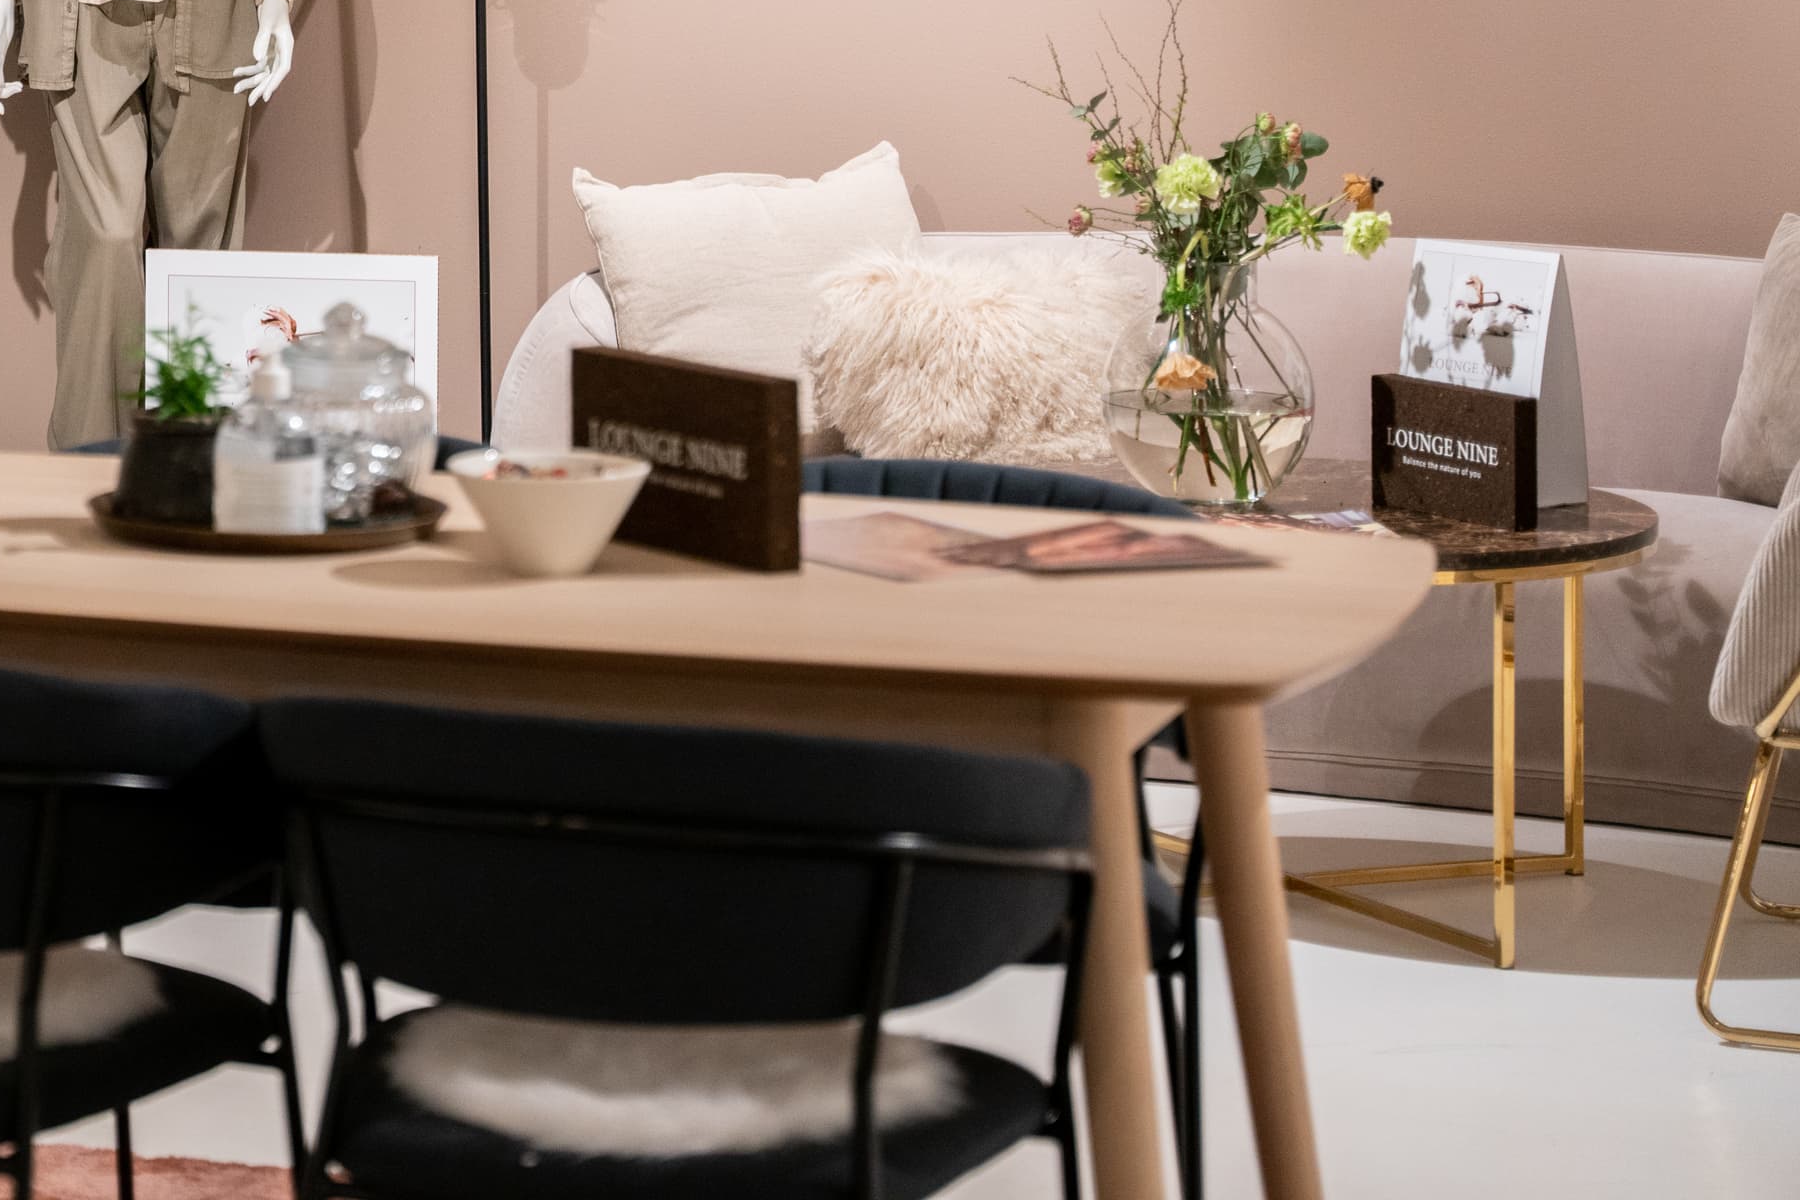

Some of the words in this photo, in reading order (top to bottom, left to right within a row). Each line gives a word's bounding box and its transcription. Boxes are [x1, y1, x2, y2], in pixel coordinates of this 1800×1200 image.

[1387, 427, 1454, 457] LOUNGE
[1457, 440, 1499, 466] NINE
[1402, 455, 1427, 468] Balance
[1427, 460, 1439, 471] the
[1439, 464, 1460, 475] nature
[1460, 467, 1469, 476] of
[1469, 470, 1482, 480] you
